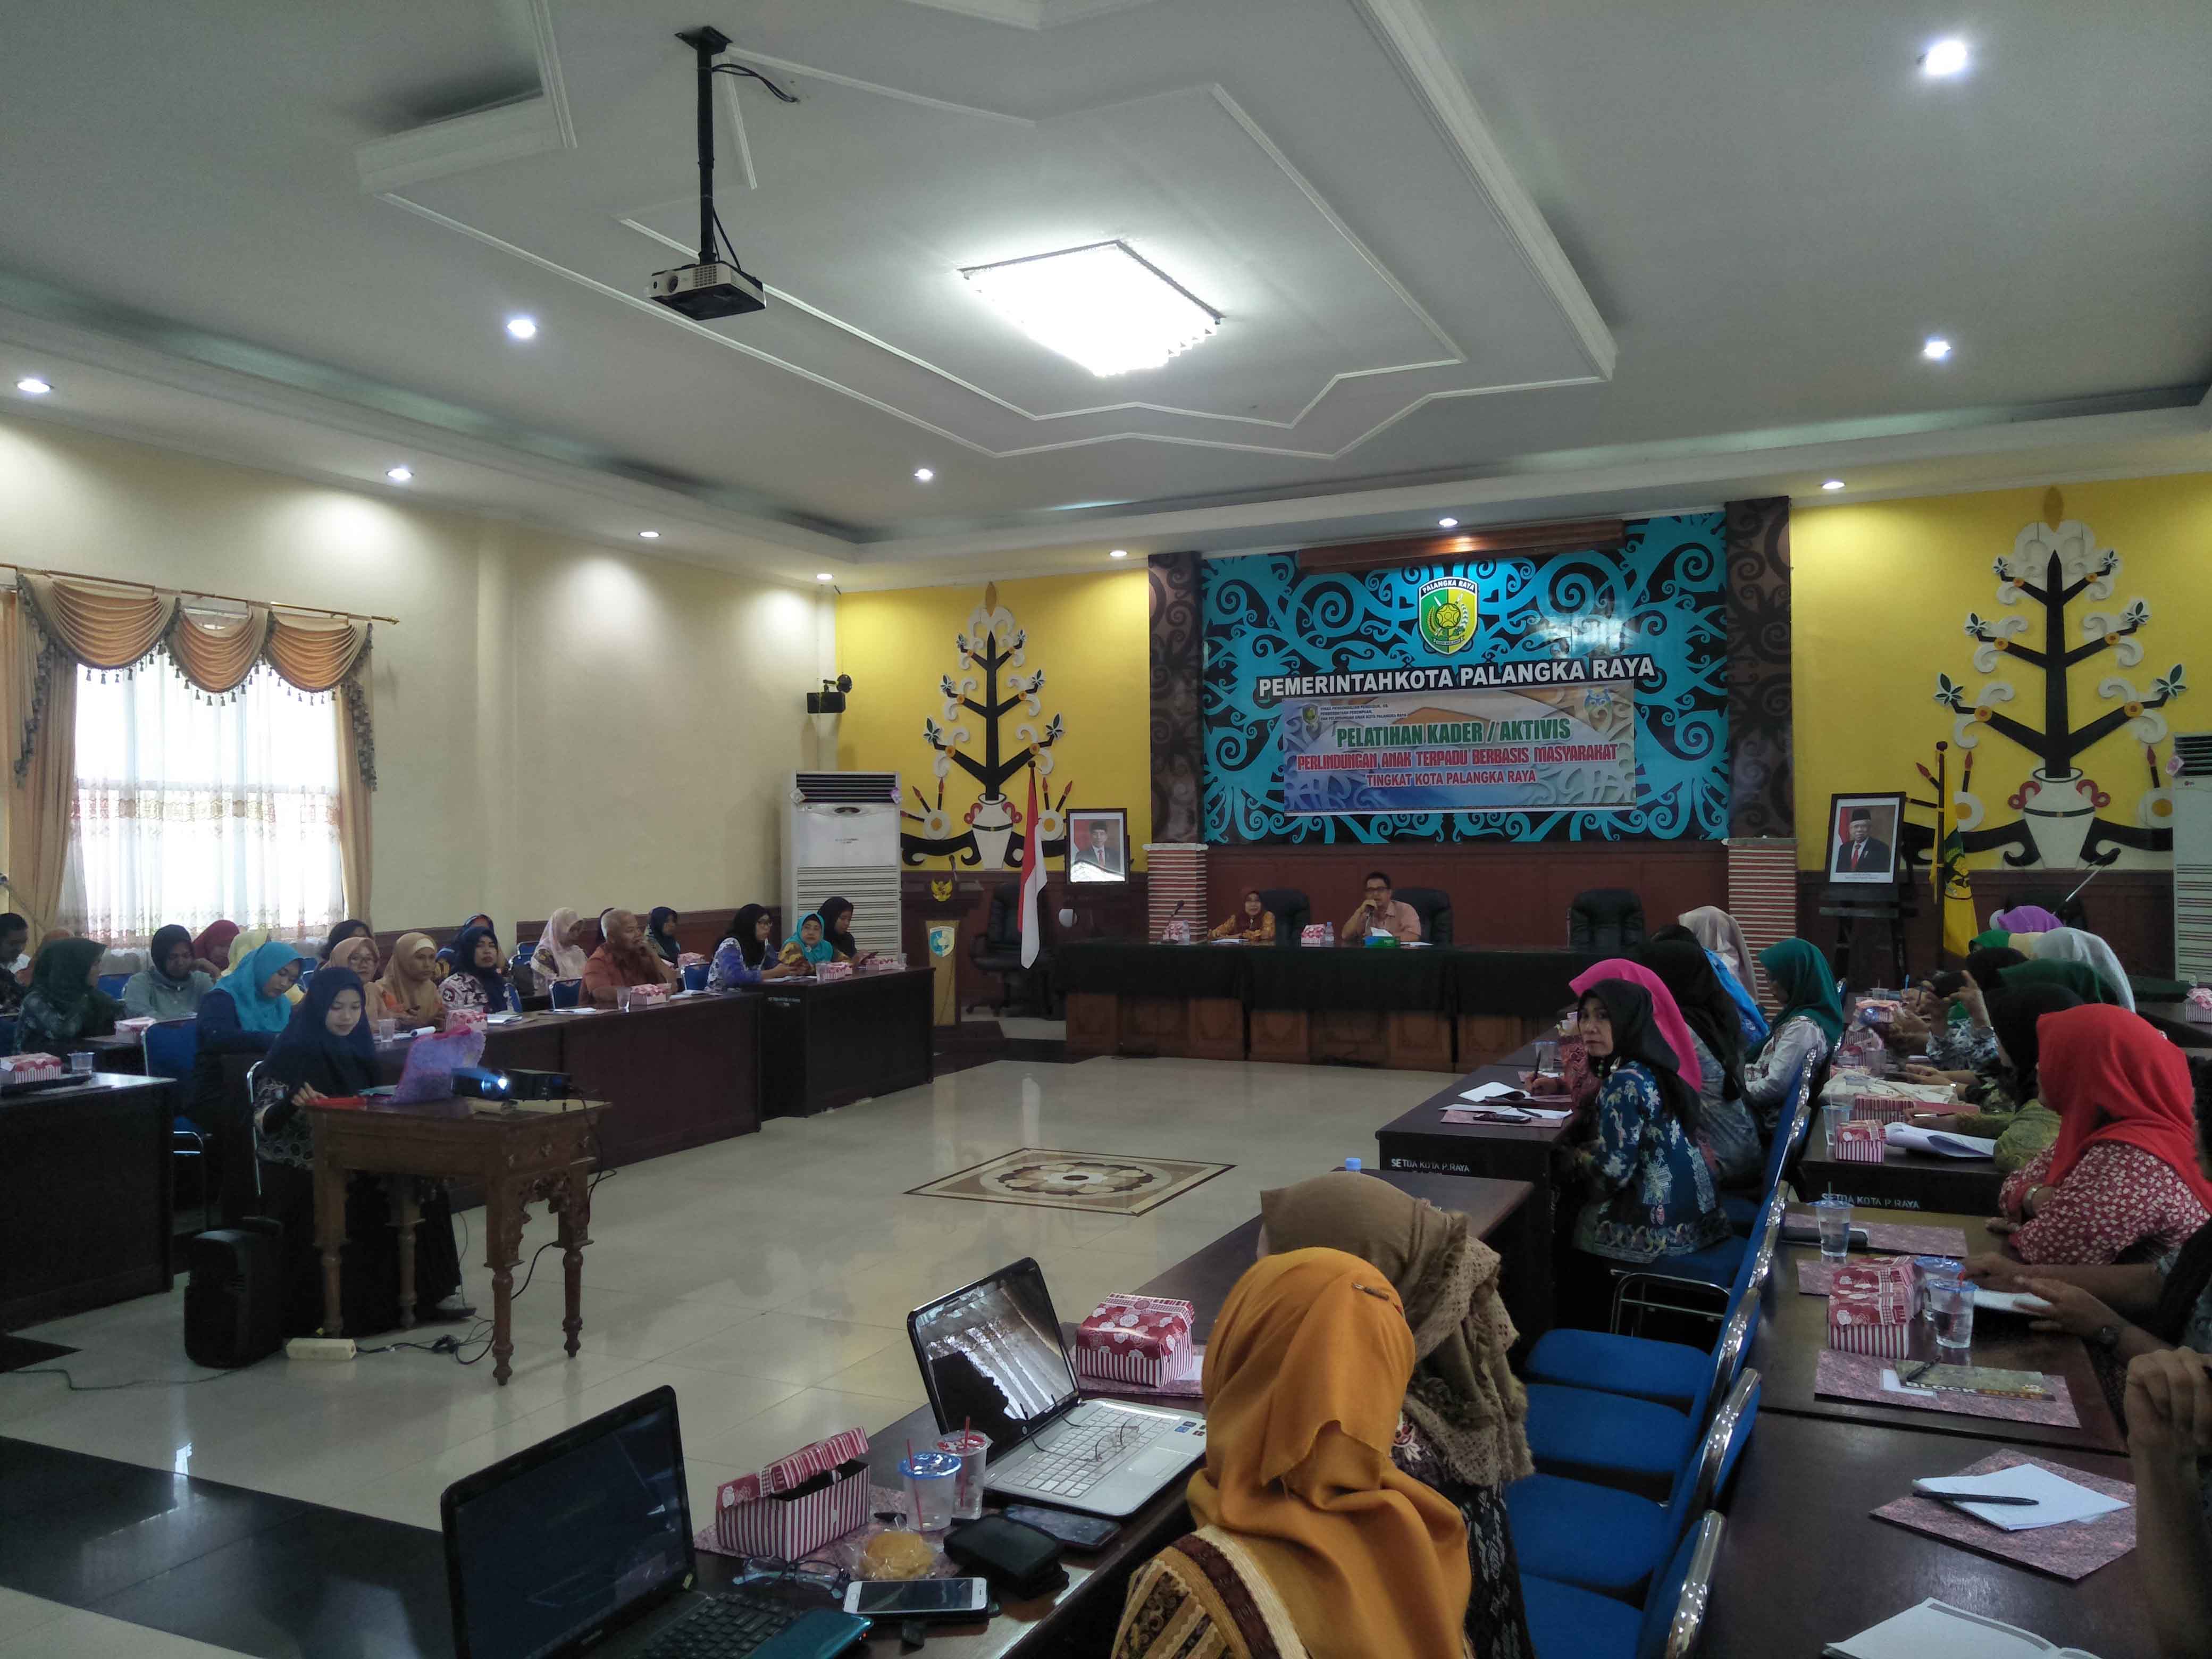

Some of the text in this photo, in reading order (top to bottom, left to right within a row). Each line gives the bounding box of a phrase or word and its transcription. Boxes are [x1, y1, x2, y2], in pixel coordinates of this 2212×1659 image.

[1422, 580, 1474, 593] PALANGKA RAYA
[1460, 661, 1585, 686] PALANGKA
[1593, 657, 1655, 680] RAYA
[1337, 725, 1423, 747] PELATIHAN
[1428, 723, 1483, 744] KADER
[1499, 718, 1570, 741] AKTIVIS
[1297, 744, 1618, 770] PERLINDUNGAN ANAK TERPADU BERBASIS MASYARAKAT
[1367, 769, 1536, 787] TINGKAT KOTA PALANGKA RAYA
[1857, 1196, 1881, 1205] KOTA
